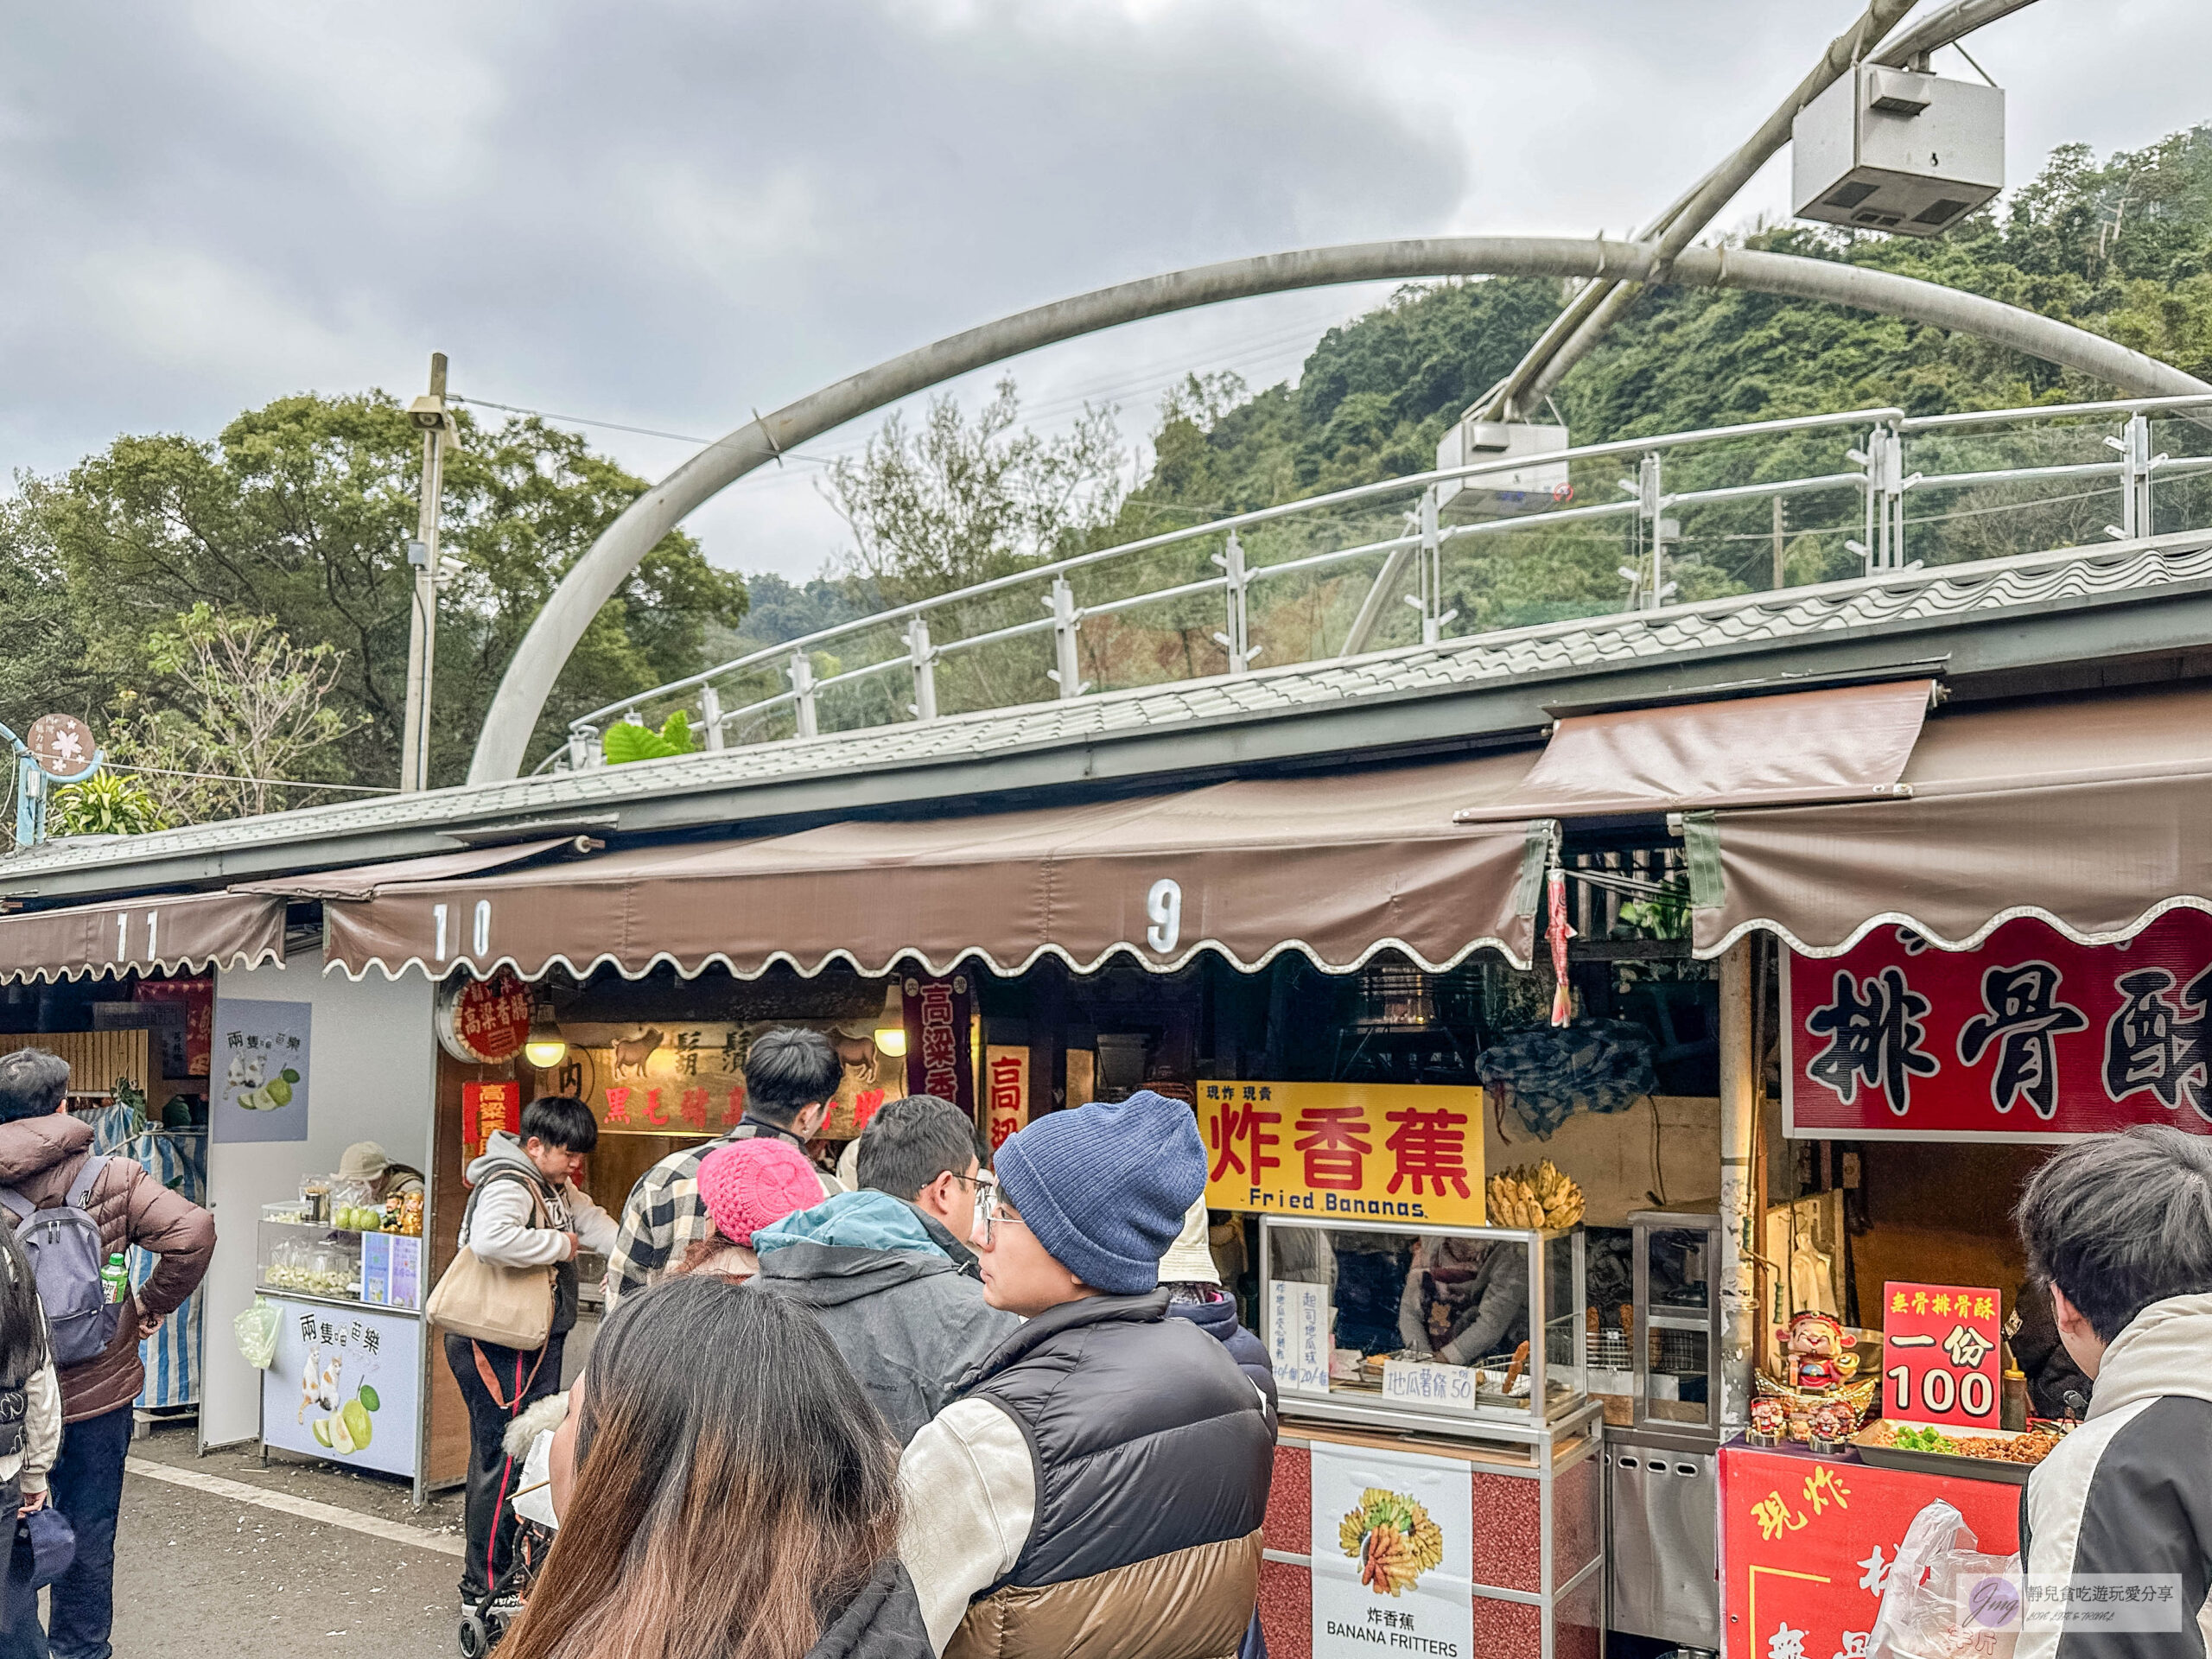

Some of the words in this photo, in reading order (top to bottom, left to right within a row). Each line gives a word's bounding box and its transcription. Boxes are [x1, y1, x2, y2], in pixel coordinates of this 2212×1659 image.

[117, 910, 158, 963] 11
[433, 899, 492, 961] 10
[1147, 879, 1182, 954] 9
[1210, 1102, 1471, 1199] 炸香蕉
[1249, 1188, 1314, 1211] Fried
[1890, 1291, 1996, 1320] 無骨排骨酥
[1890, 1324, 1996, 1370] 一份
[1451, 1378, 1471, 1398] 50
[1886, 1364, 1994, 1417] 100
[1751, 1465, 1852, 1541] 現炸
[1327, 1620, 1384, 1645] BANANA
[1389, 1632, 1458, 1657] FRITTERS
[1367, 1607, 1414, 1631] 炸香蕉
